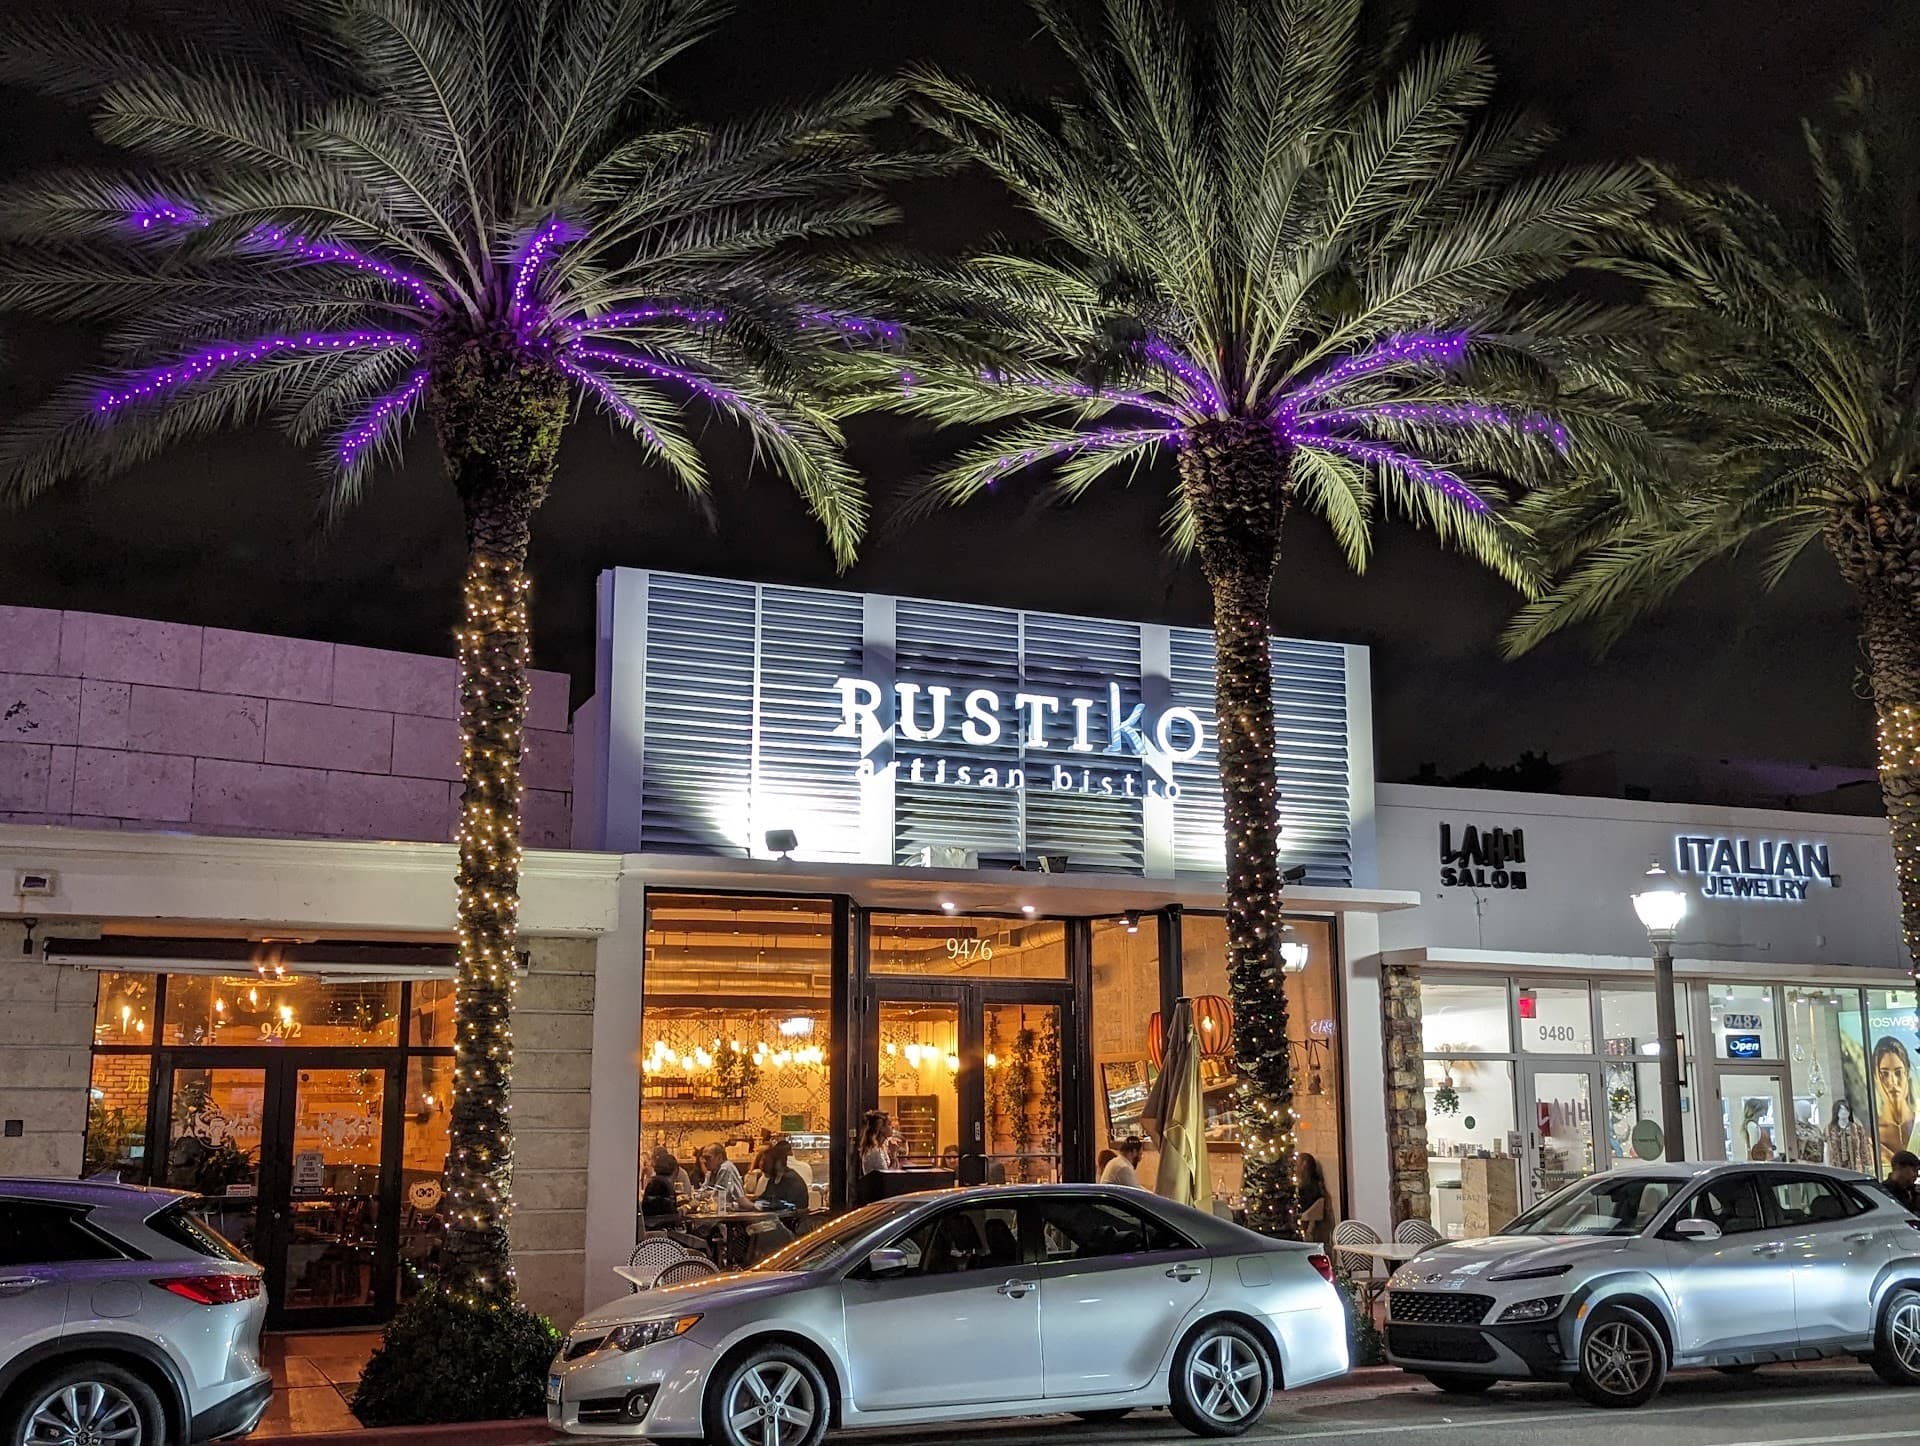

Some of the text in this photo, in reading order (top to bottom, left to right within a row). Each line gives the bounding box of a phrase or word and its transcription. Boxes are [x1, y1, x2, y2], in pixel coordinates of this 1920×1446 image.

[855, 756, 1182, 800] artisan bistro
[1677, 836, 1832, 879] ITALIAN
[1440, 867, 1527, 890] SALON
[1703, 874, 1809, 900] JEWELRY
[946, 937, 993, 961] 9476
[260, 1020, 302, 1040] 9472
[1539, 1025, 1574, 1041] 9480
[1725, 1014, 1762, 1029] 9482
[1730, 1040, 1760, 1052] Open
